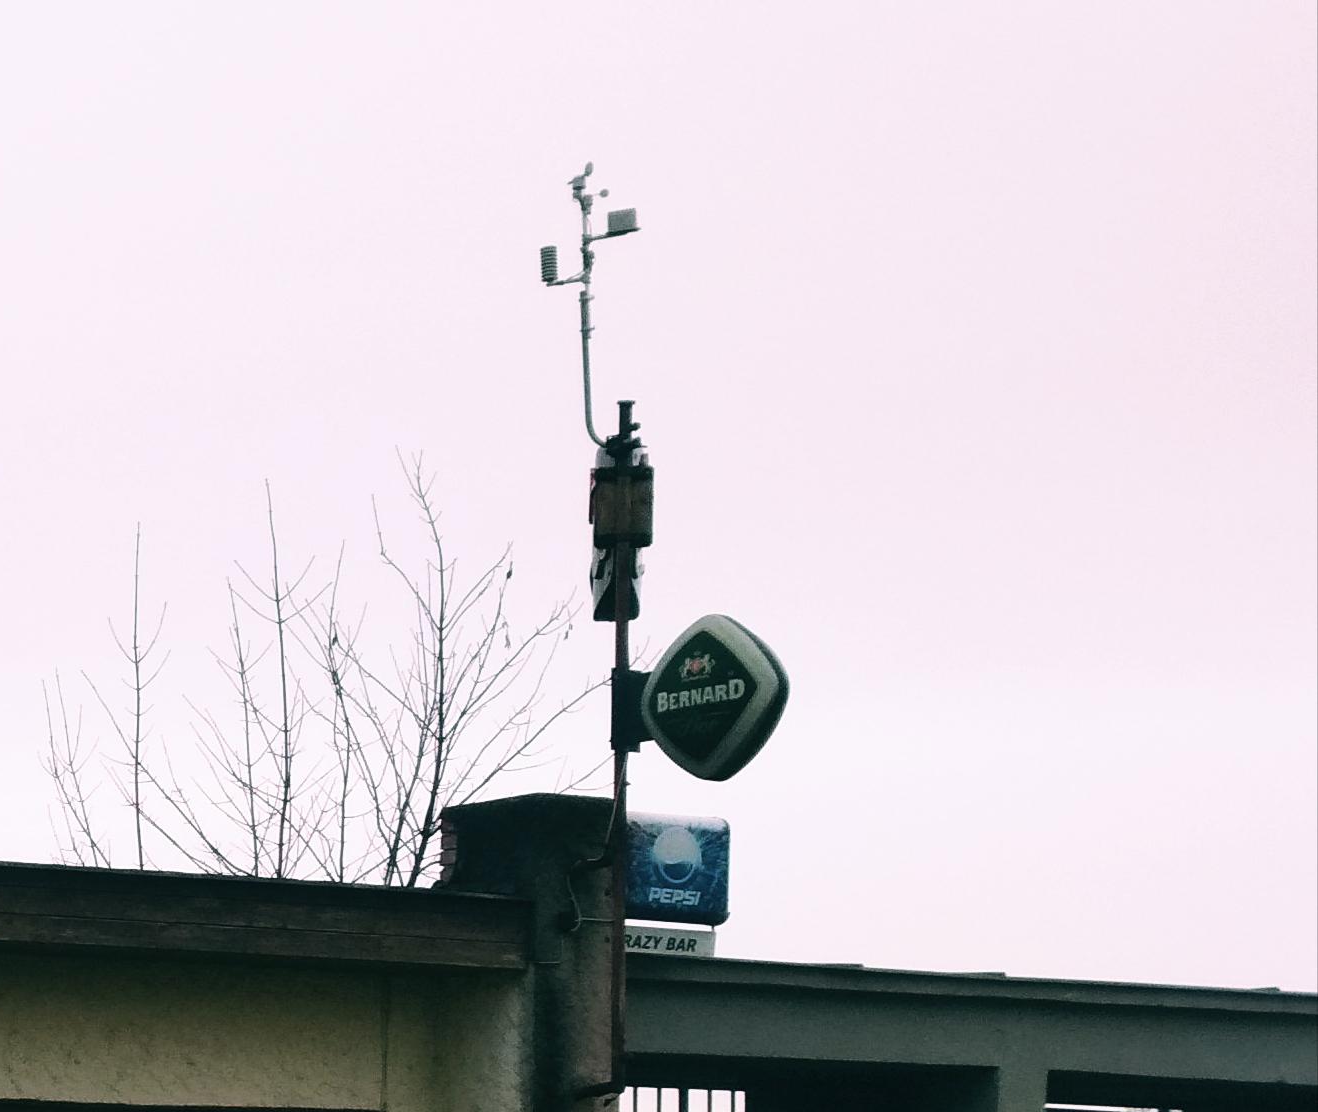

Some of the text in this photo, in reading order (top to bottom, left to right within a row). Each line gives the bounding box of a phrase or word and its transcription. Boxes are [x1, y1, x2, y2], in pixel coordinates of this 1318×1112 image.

[656, 678, 745, 713] BERNARD
[649, 886, 701, 906] PEPSI
[624, 934, 697, 953] RAZY BAR
